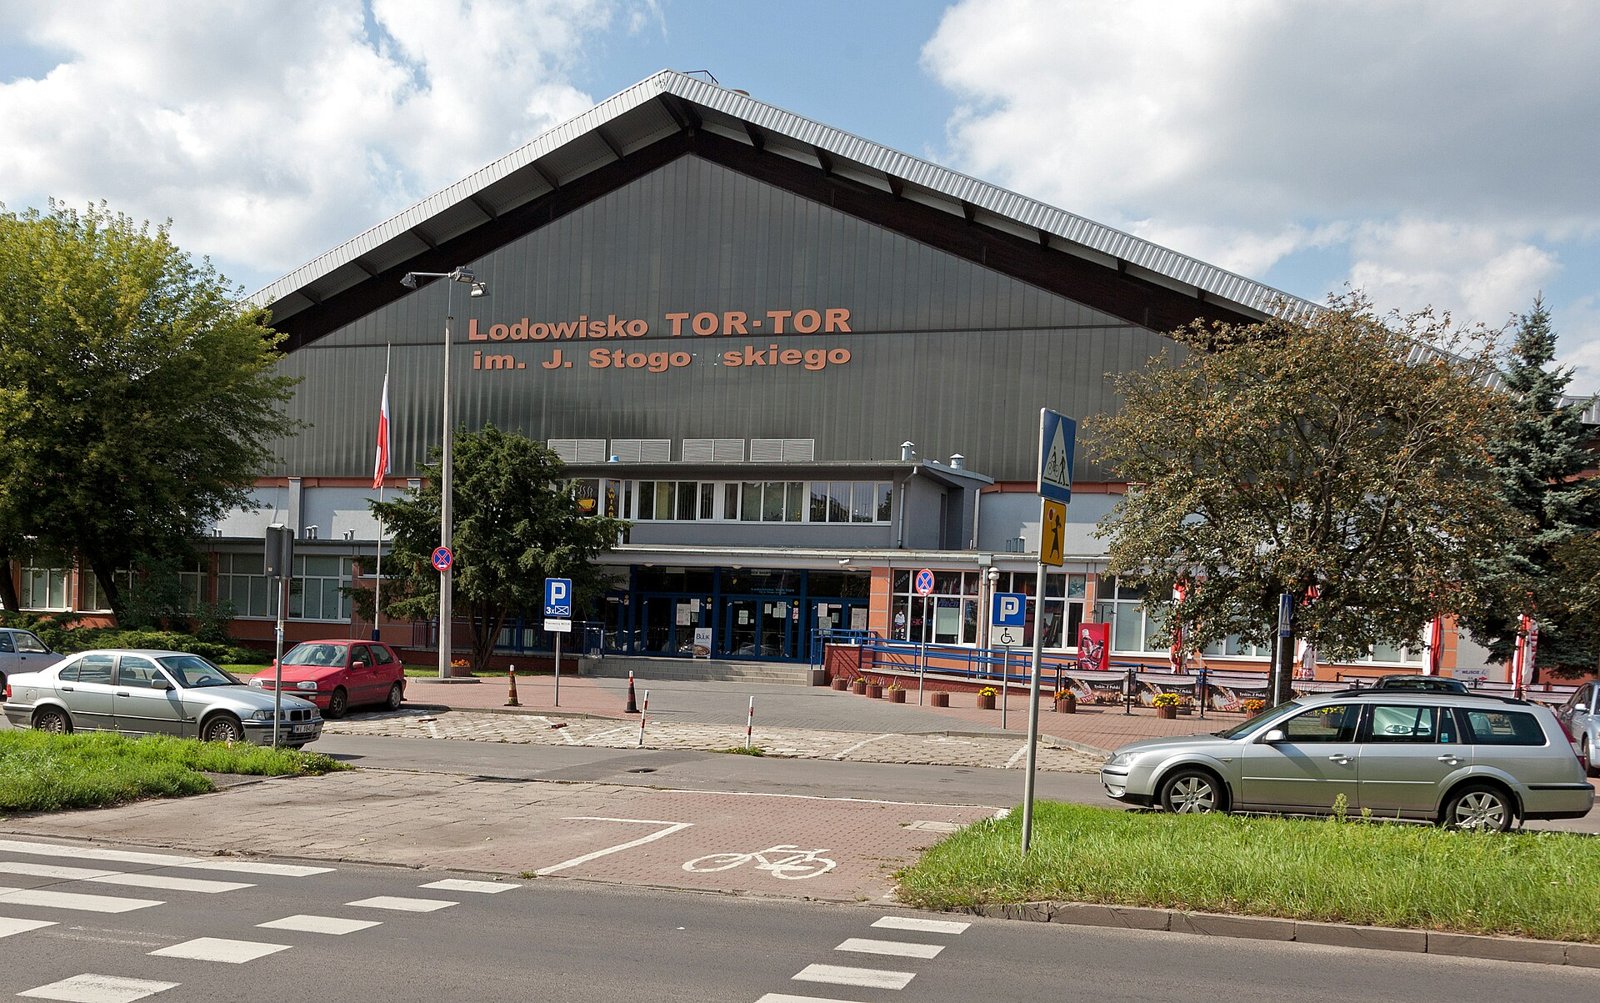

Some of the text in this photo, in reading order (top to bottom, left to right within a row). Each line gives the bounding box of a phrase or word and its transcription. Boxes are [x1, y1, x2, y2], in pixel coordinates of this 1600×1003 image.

[468, 308, 852, 341] Lodowisko TOR-TOR
[473, 351, 527, 370] im.
[541, 349, 573, 369] J.
[550, 582, 566, 605] P
[1000, 596, 1019, 622] P
